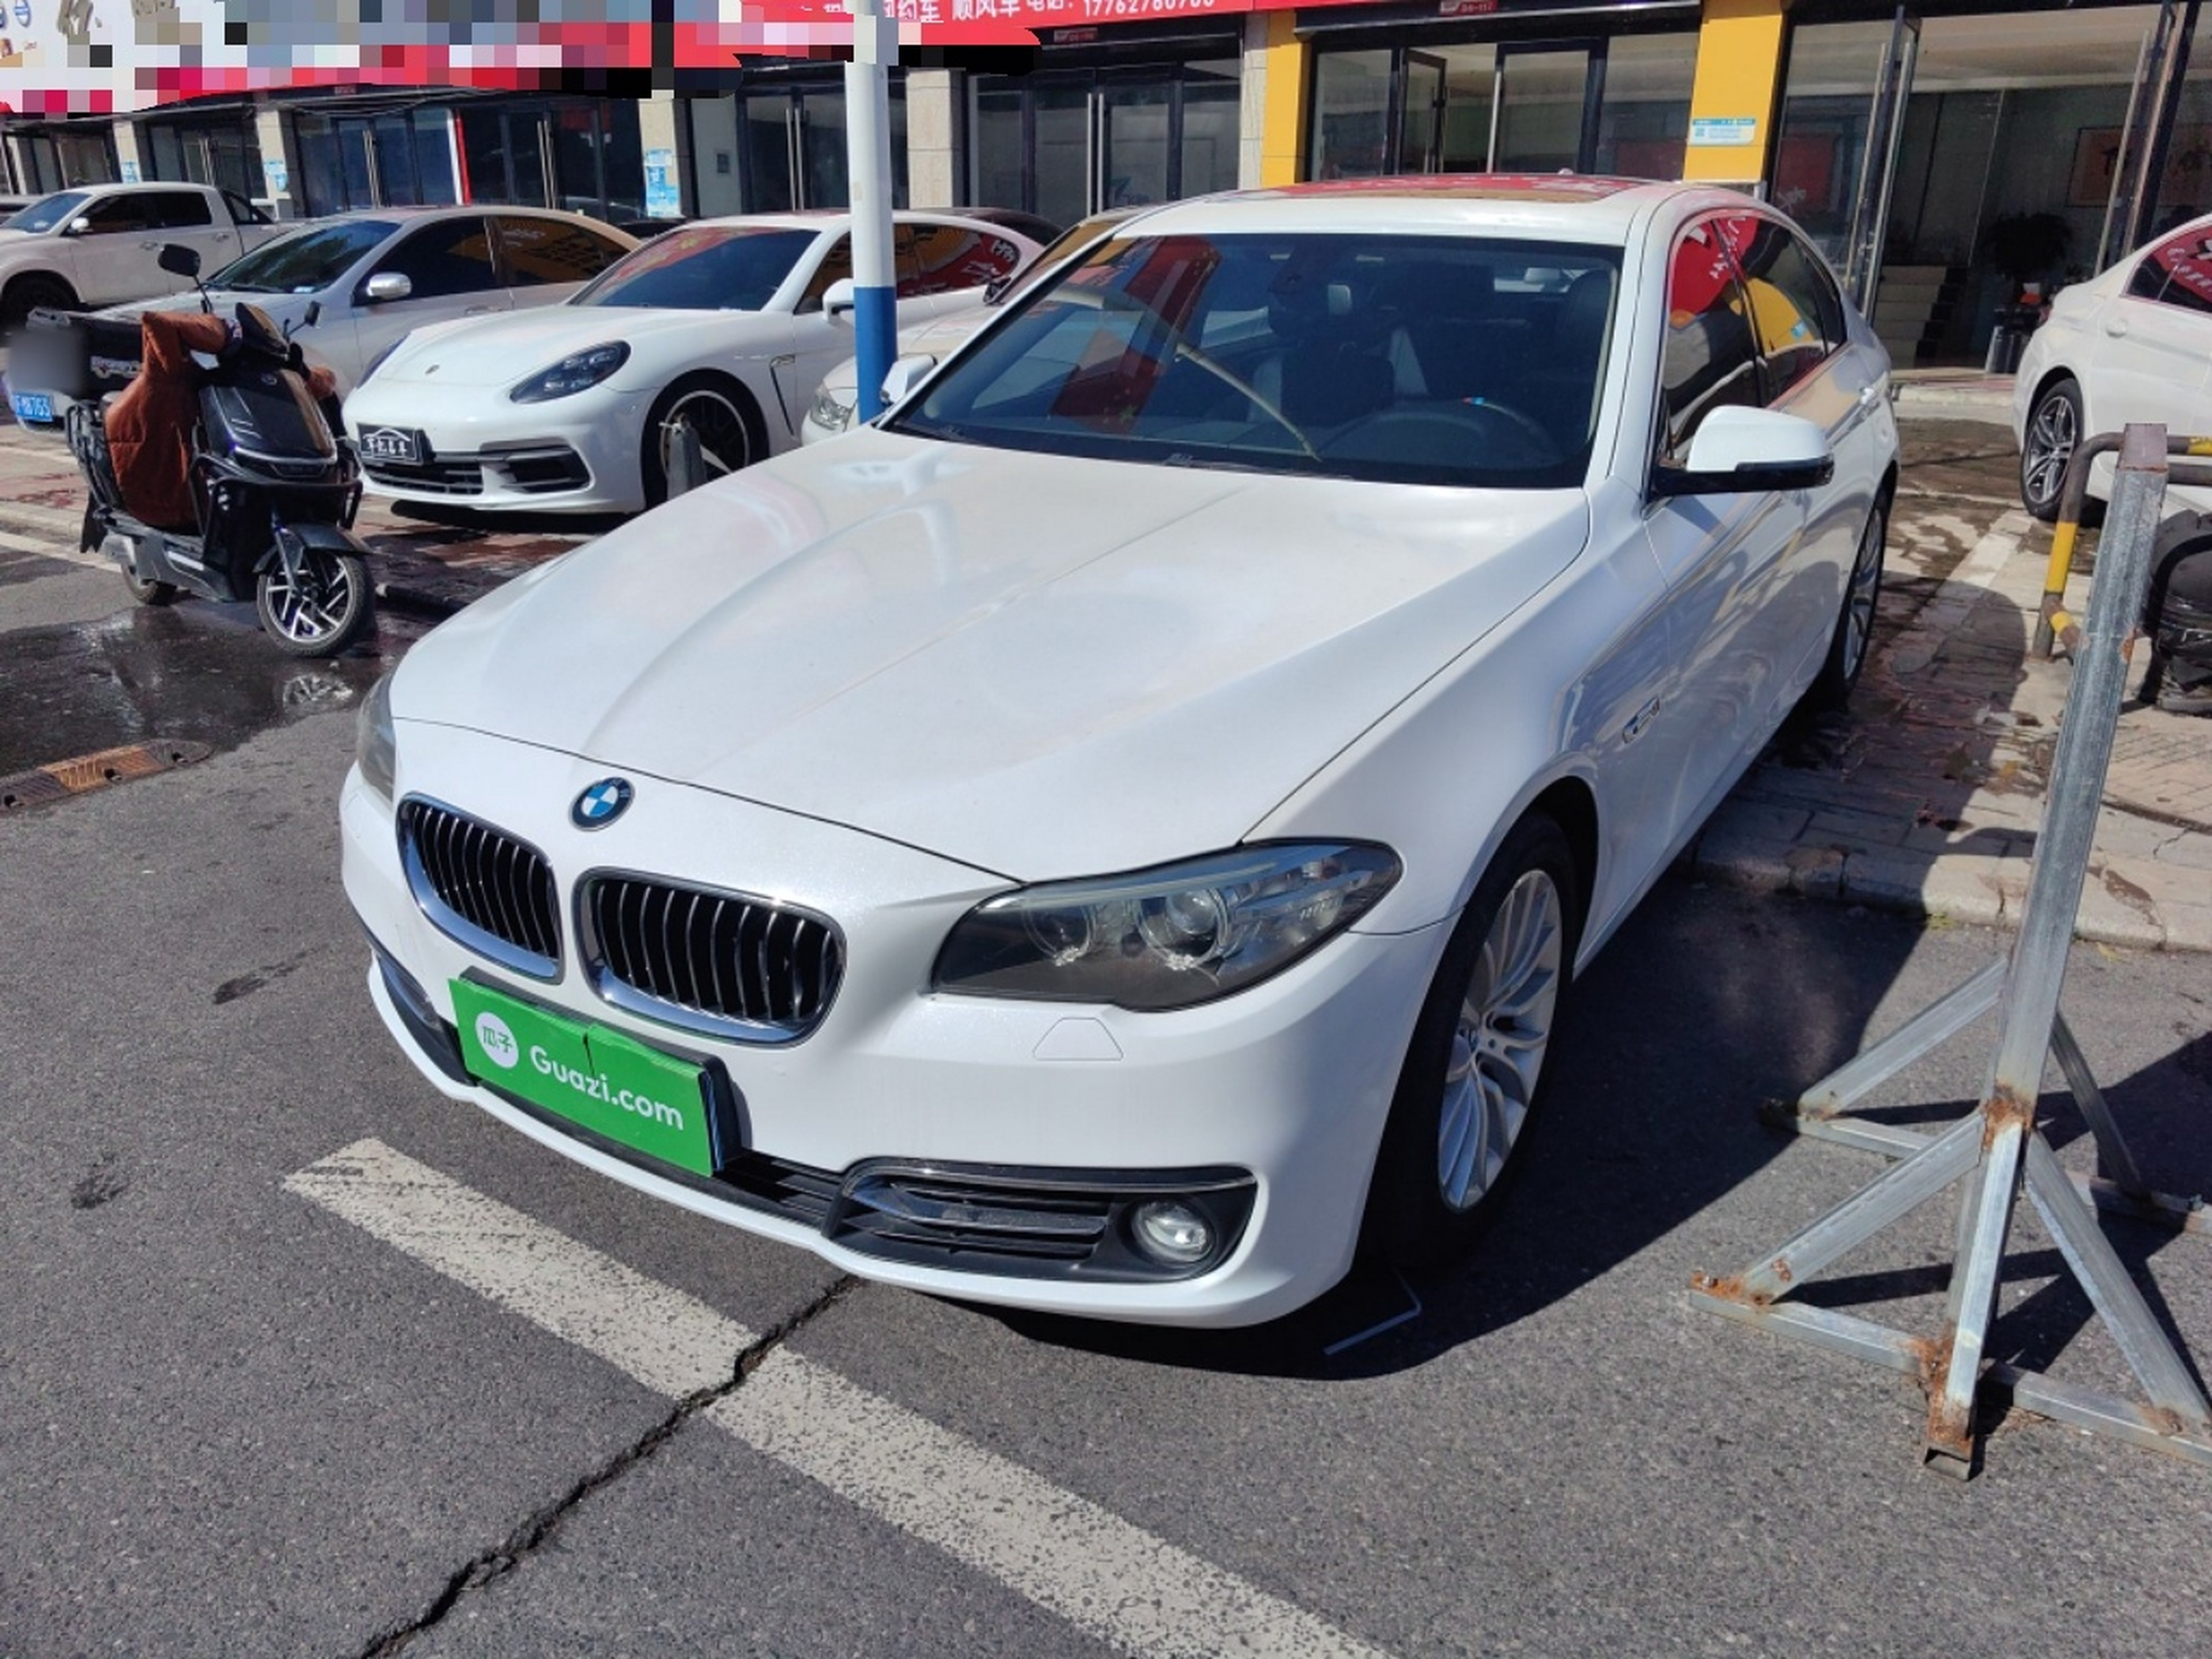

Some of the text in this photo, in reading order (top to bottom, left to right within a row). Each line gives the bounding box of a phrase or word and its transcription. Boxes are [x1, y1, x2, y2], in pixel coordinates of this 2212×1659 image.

[952, 0, 1020, 20] 顺风车
[482, 1025, 513, 1053] 瓜子
[530, 1046, 684, 1130] Guazi.com
